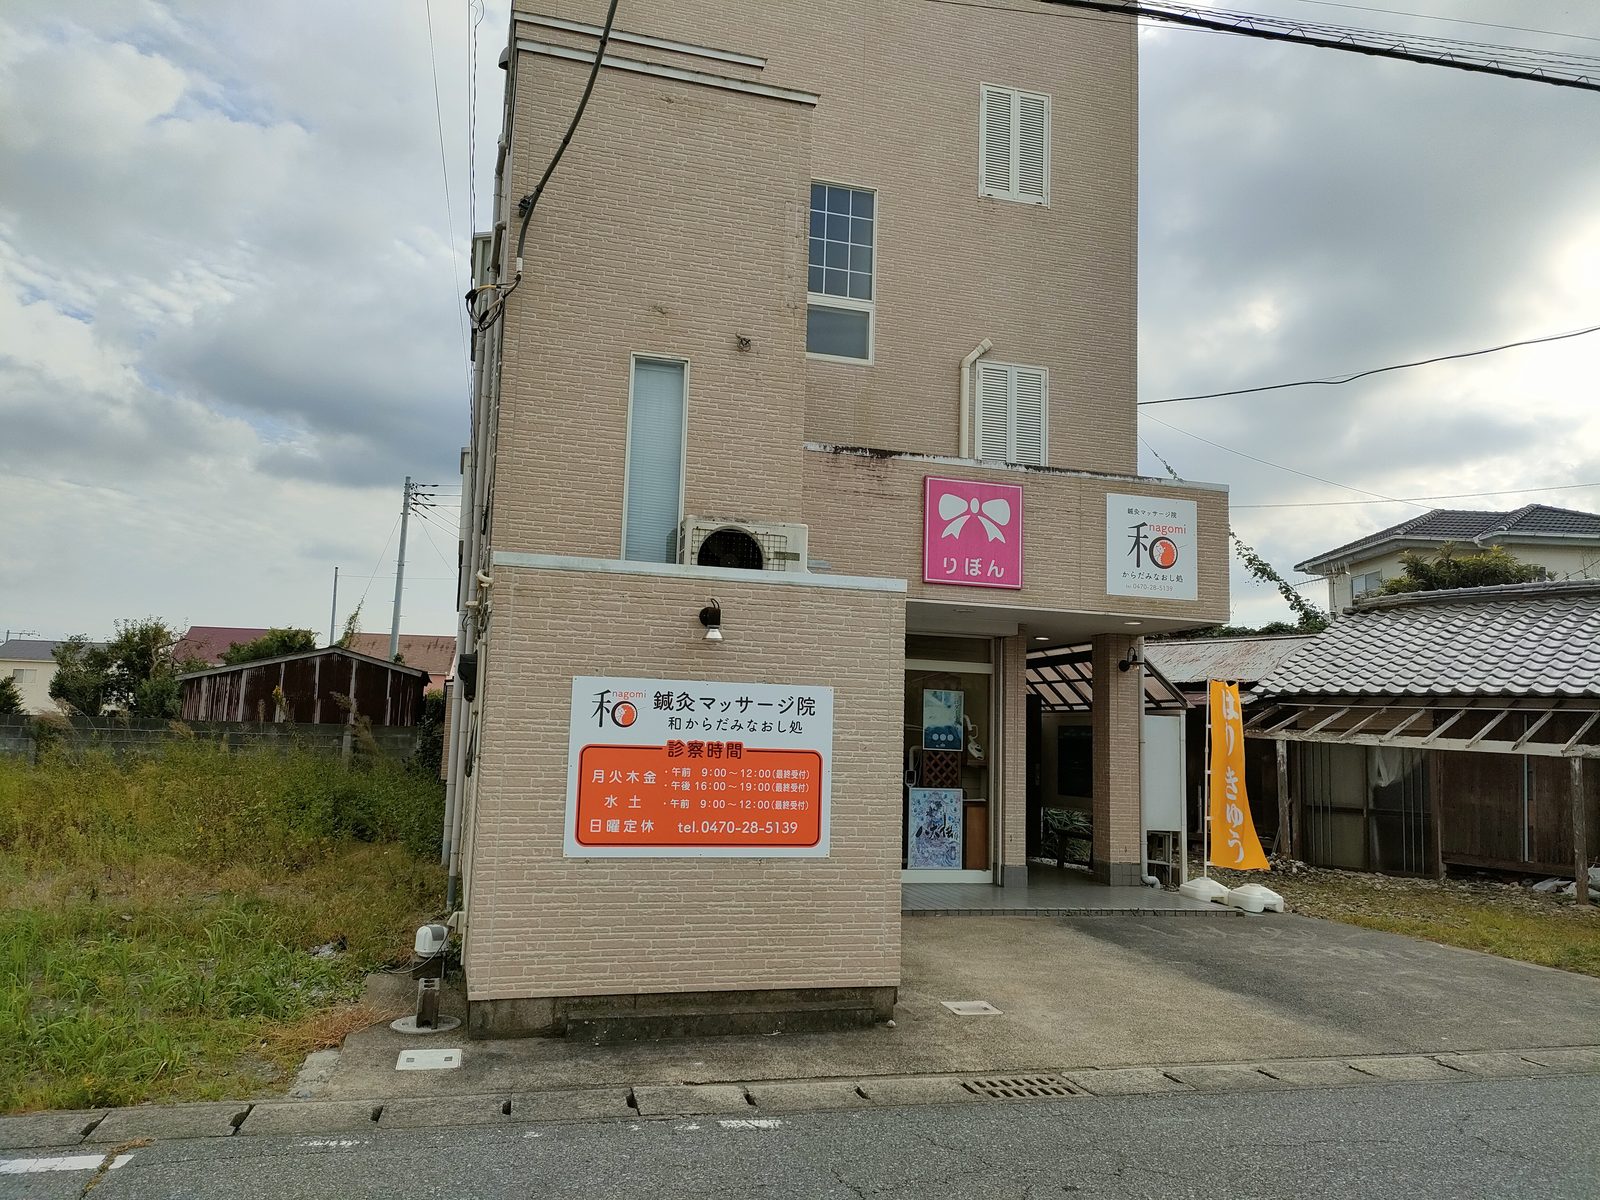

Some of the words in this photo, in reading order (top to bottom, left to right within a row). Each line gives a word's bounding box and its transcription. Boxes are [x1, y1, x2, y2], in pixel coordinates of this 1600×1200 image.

[1127, 507, 1177, 519] 鍼灸マッサージ院
[1149, 523, 1187, 536] nagomi
[943, 557, 1005, 578] りぼん
[1122, 571, 1184, 583] からだみなおし処
[1132, 583, 1173, 592] 0470-28-5139
[612, 690, 647, 700] nagomi
[653, 690, 816, 716] 鍼灸マッサージ院
[667, 716, 803, 734] 和からだみなおし処
[667, 740, 743, 760] 診察時間
[589, 818, 655, 833] 日曜定休
